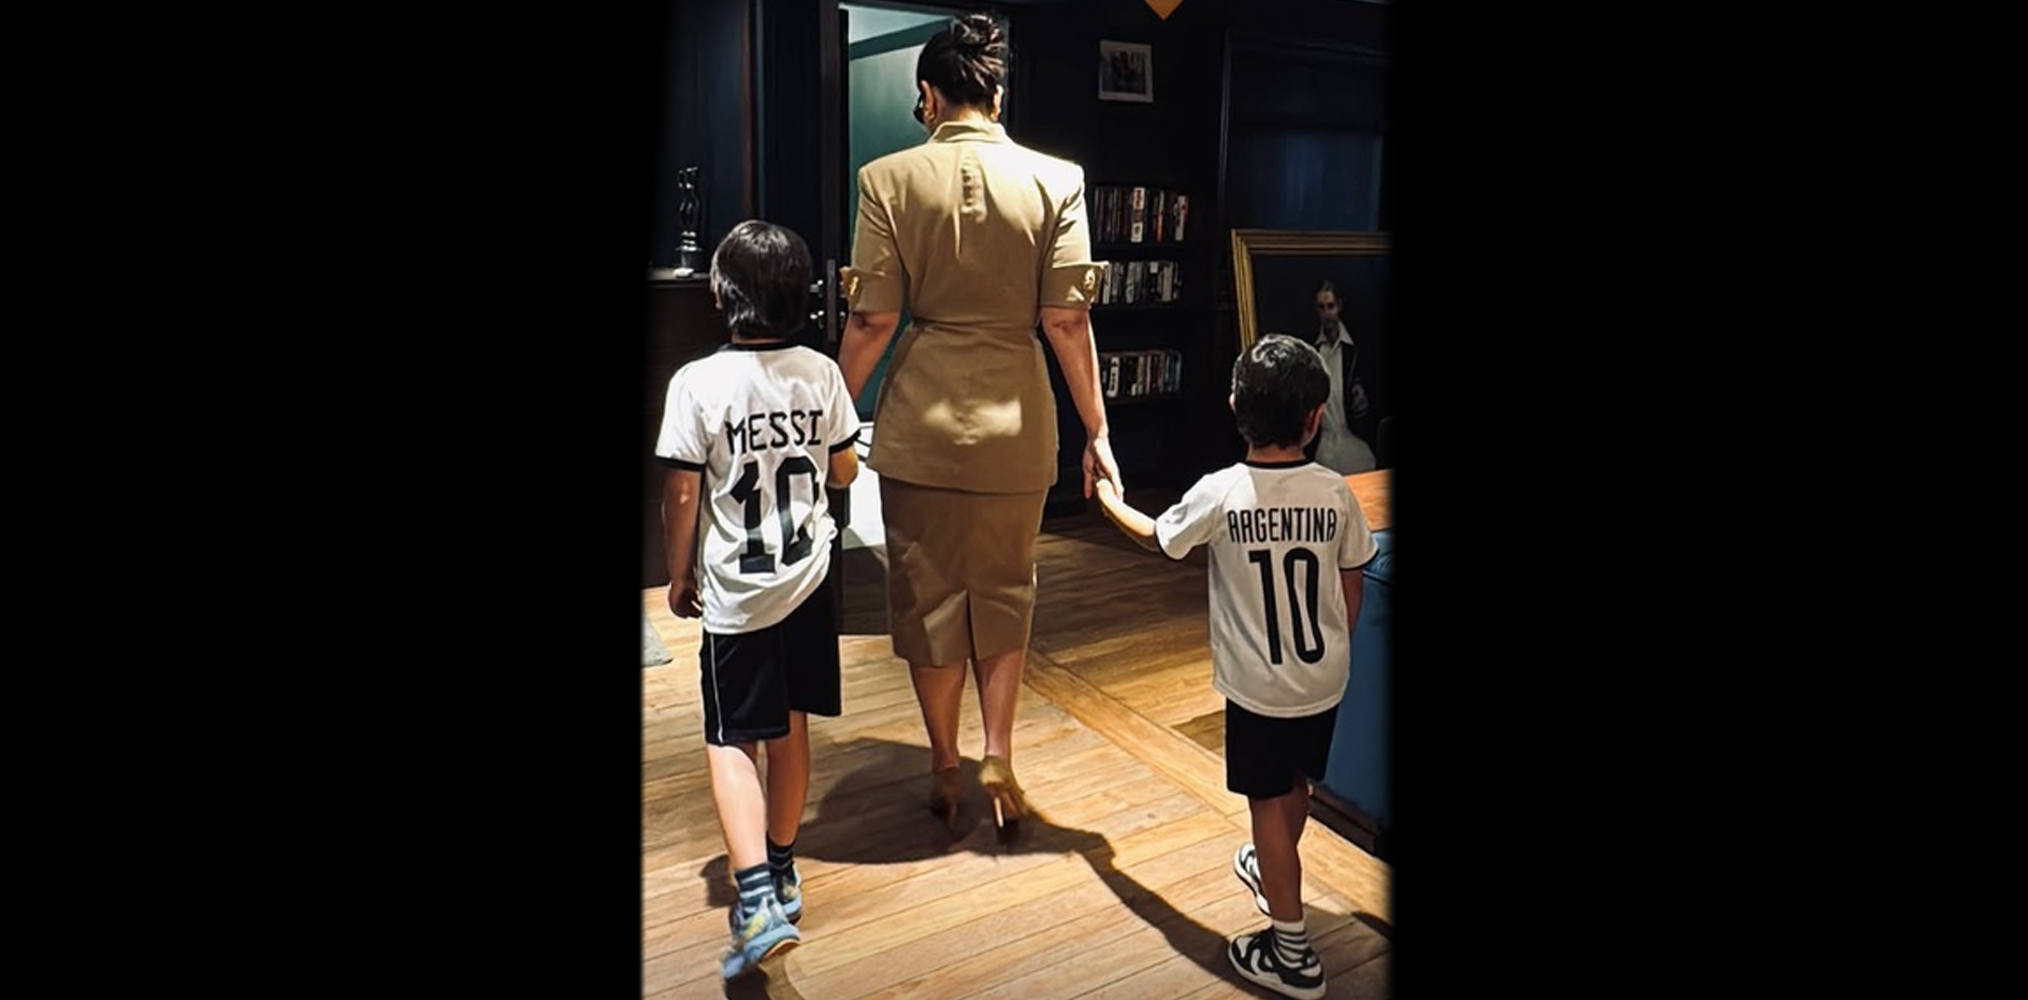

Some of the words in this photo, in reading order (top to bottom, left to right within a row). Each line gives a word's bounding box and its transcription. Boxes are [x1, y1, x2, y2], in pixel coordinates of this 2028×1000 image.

[725, 410, 823, 455] MESSI
[730, 455, 819, 573] 10
[1227, 507, 1337, 543] ARGENTINA
[1248, 547, 1325, 665] 10
